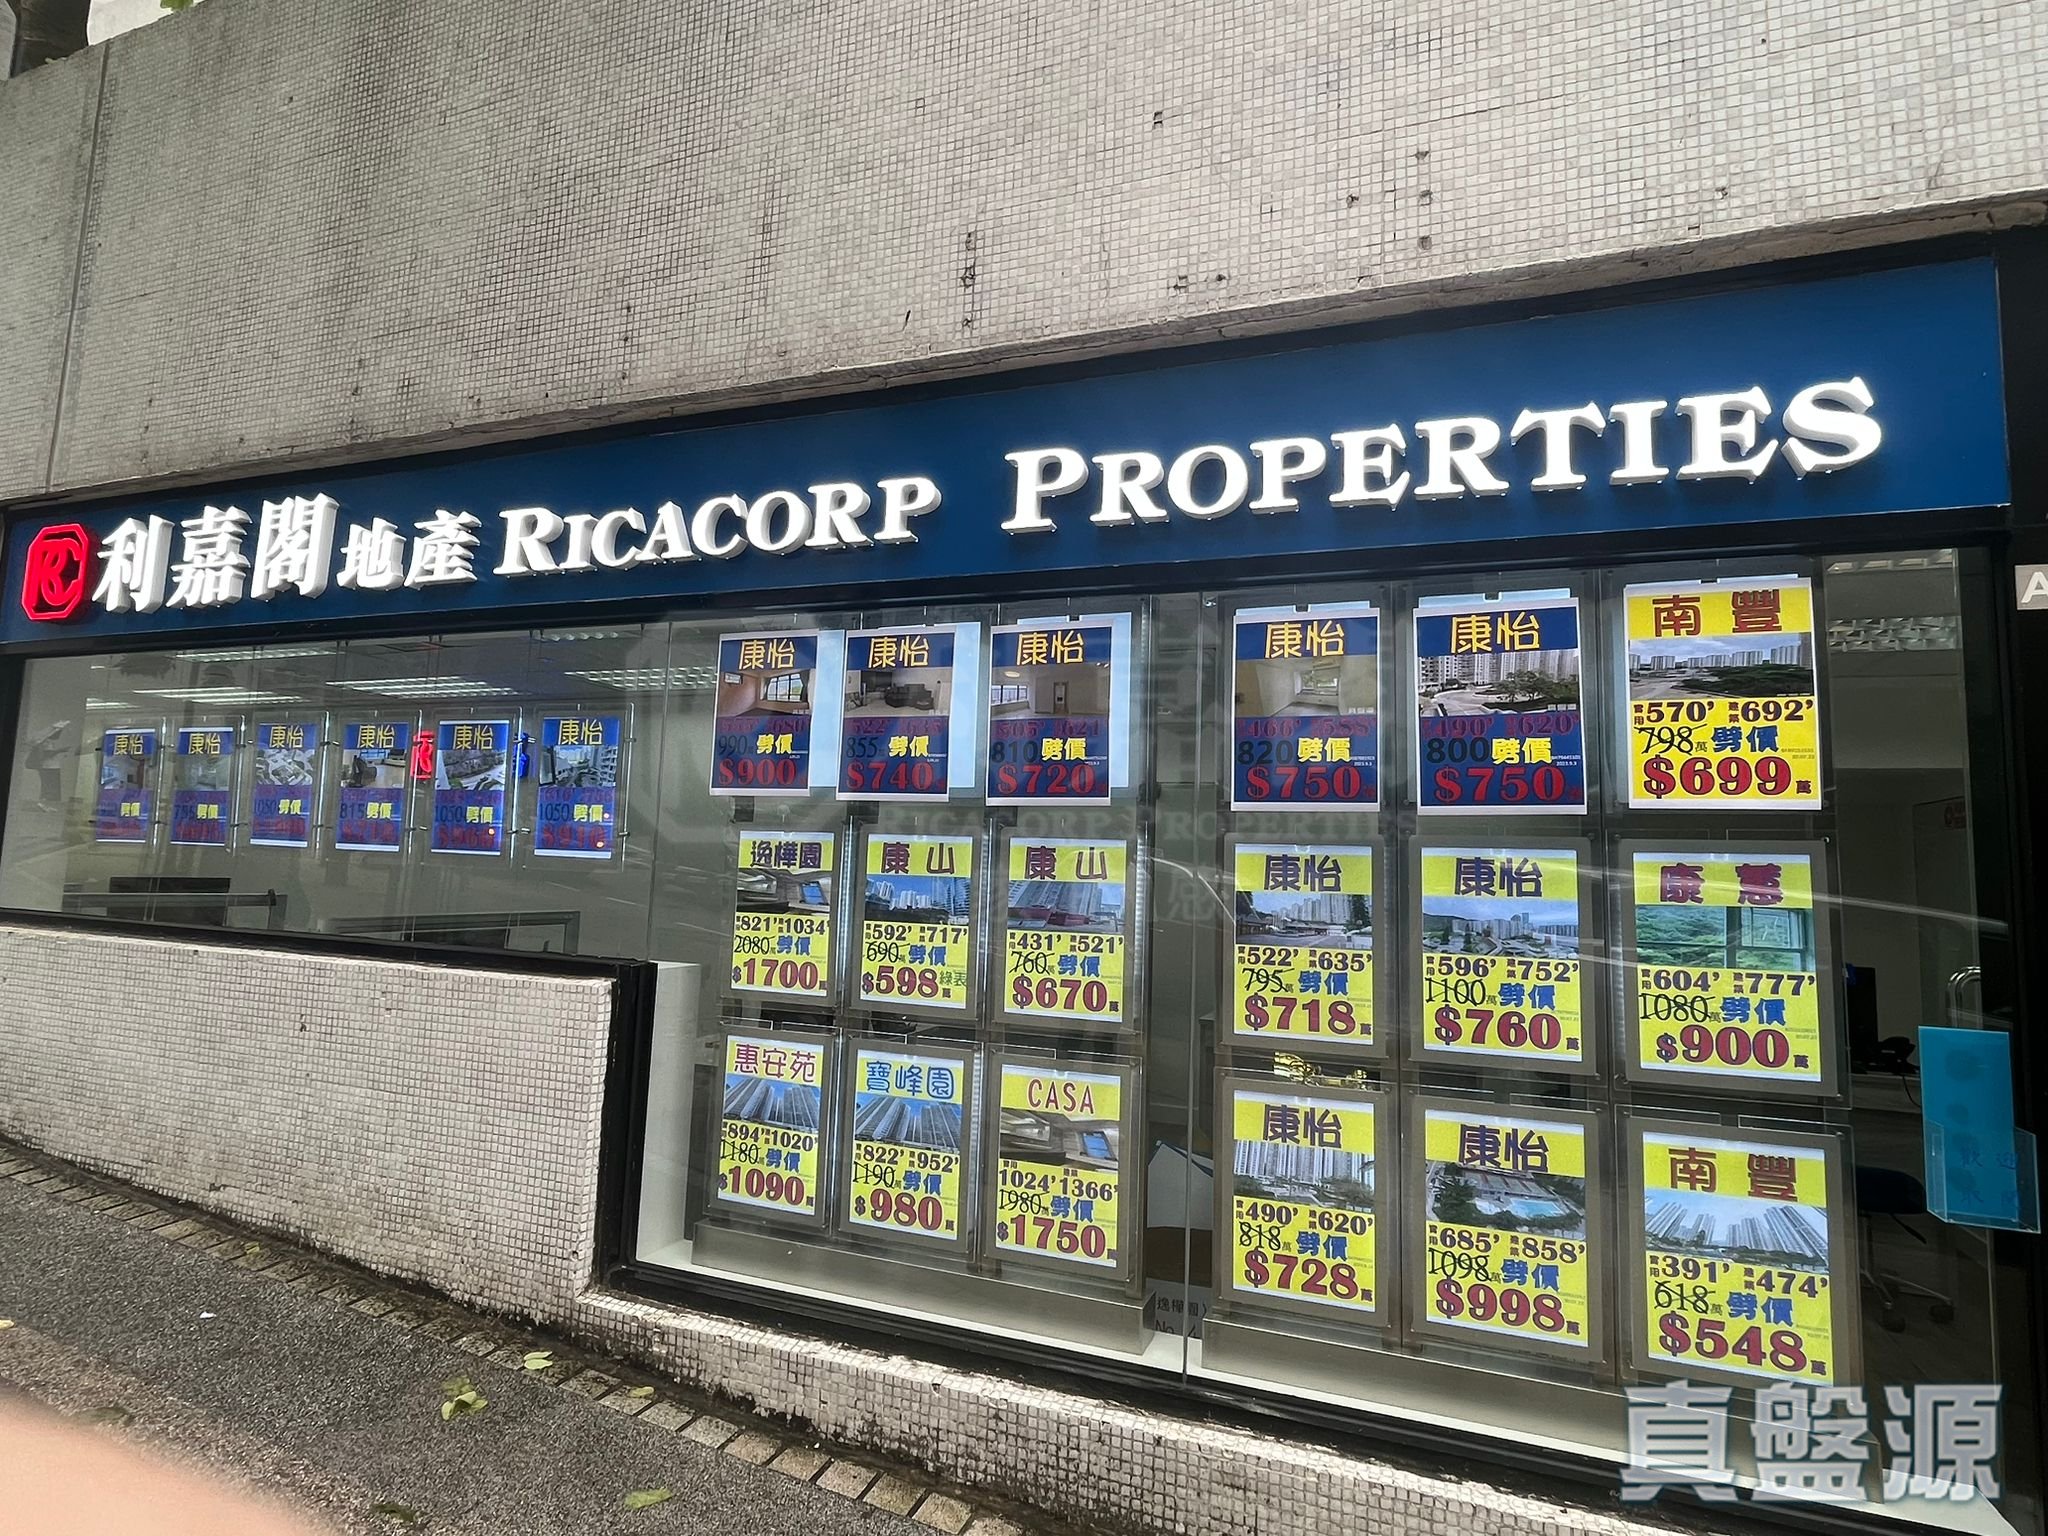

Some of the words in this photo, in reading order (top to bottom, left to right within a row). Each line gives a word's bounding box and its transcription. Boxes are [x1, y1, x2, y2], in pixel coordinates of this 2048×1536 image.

[493, 477, 942, 578] RICACORP
[1001, 376, 1883, 534] PROPERTIES
[1652, 589, 1782, 637] 南豐
[1265, 620, 1345, 659] 康怡
[1451, 611, 1540, 653] 康怡
[739, 638, 795, 670] 康怡
[868, 635, 929, 668] 康怡
[1016, 630, 1084, 665] 康怡
[1646, 701, 1715, 723] 570'
[1741, 700, 1813, 722] 692'
[113, 734, 144, 755] 康怡
[188, 732, 221, 755] 康怡
[269, 725, 304, 749] 康怡
[357, 725, 395, 749] 康怡
[453, 724, 493, 750] 康怡
[558, 719, 603, 745] 康怡
[756, 734, 793, 754] 劈價
[889, 735, 928, 757] 劈價
[1711, 725, 1778, 753] 劈價
[1042, 738, 1086, 761] 劈價
[1238, 740, 1293, 765] 820
[1298, 738, 1352, 762] 劈價
[1427, 738, 1488, 764] 800
[1492, 737, 1552, 764] 劈價
[719, 759, 796, 785] $900
[848, 762, 934, 789] $740
[997, 764, 1095, 794] $720
[1247, 766, 1361, 799] $750
[1434, 766, 1565, 802] $750
[881, 842, 954, 875] 康山
[1024, 846, 1107, 880] 康山
[1264, 854, 1341, 892] 康怡
[1455, 857, 1542, 897] 康怡
[777, 935, 811, 956] 劈價
[872, 924, 912, 942] 592'
[928, 927, 967, 944] 717'
[1017, 934, 1062, 950] 431'
[1078, 935, 1123, 954] 521'
[909, 945, 946, 966] 劈價
[1058, 955, 1100, 977] 劈價
[1247, 946, 1298, 967] 522'
[1319, 951, 1372, 972] 635'
[1438, 957, 1496, 978] 596'
[1518, 960, 1579, 982] 752'
[1298, 971, 1348, 996] 劈價
[1498, 982, 1555, 1010] 劈價
[1653, 970, 1720, 992] 604'
[1745, 973, 1815, 996] 777'
[1720, 996, 1786, 1026] 劈價
[734, 1043, 816, 1083] 惠安苑
[866, 1061, 954, 1099] 寶峰園
[1029, 1079, 1094, 1114] CASA
[1263, 1104, 1342, 1149] 康怡
[765, 1148, 800, 1174] 劈價
[1459, 1124, 1549, 1173] 康怡
[903, 1170, 941, 1196] 劈價
[999, 1169, 1055, 1192] 1024'
[1668, 1147, 1798, 1202] 南豐
[1050, 1196, 1094, 1223] 劈價
[1246, 1202, 1299, 1225] 490'
[1319, 1211, 1373, 1235] 620'
[1296, 1232, 1348, 1262] 劈價
[1440, 1228, 1500, 1253] 685'
[1522, 1238, 1585, 1264] 858'
[1500, 1259, 1559, 1292] 劈價
[1661, 1256, 1729, 1283] 391'
[1756, 1270, 1827, 1298] 474'
[1726, 1292, 1793, 1327] 劈價
